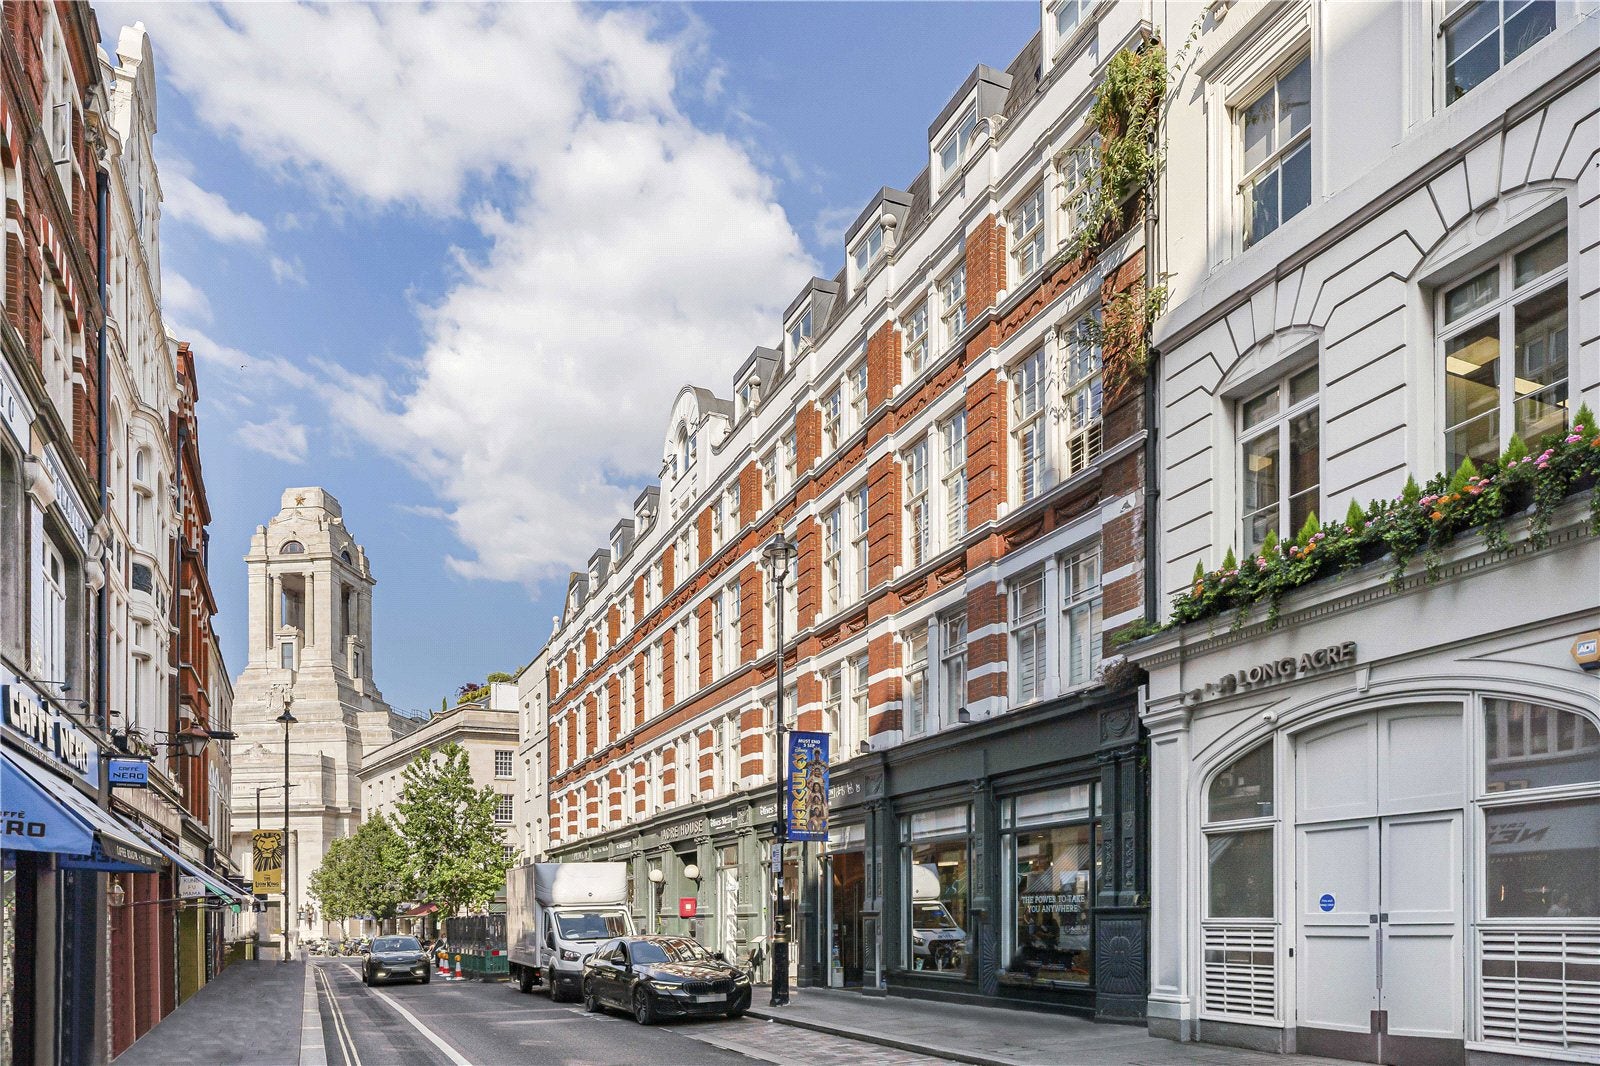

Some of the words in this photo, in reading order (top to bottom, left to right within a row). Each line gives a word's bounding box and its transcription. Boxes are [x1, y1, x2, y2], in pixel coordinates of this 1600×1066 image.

[1578, 643, 1596, 653] ADT
[1237, 656, 1297, 688] LONG
[1298, 640, 1358, 673] ACRE
[57, 726, 89, 774] NERO
[112, 772, 144, 780] NERO
[791, 753, 808, 831] HERCULES
[680, 819, 703, 836] HOUSE
[1022, 896, 1034, 904] THE
[1035, 895, 1056, 903] POWER
[1068, 894, 1085, 903] TAKE
[1027, 905, 1040, 913] YOU
